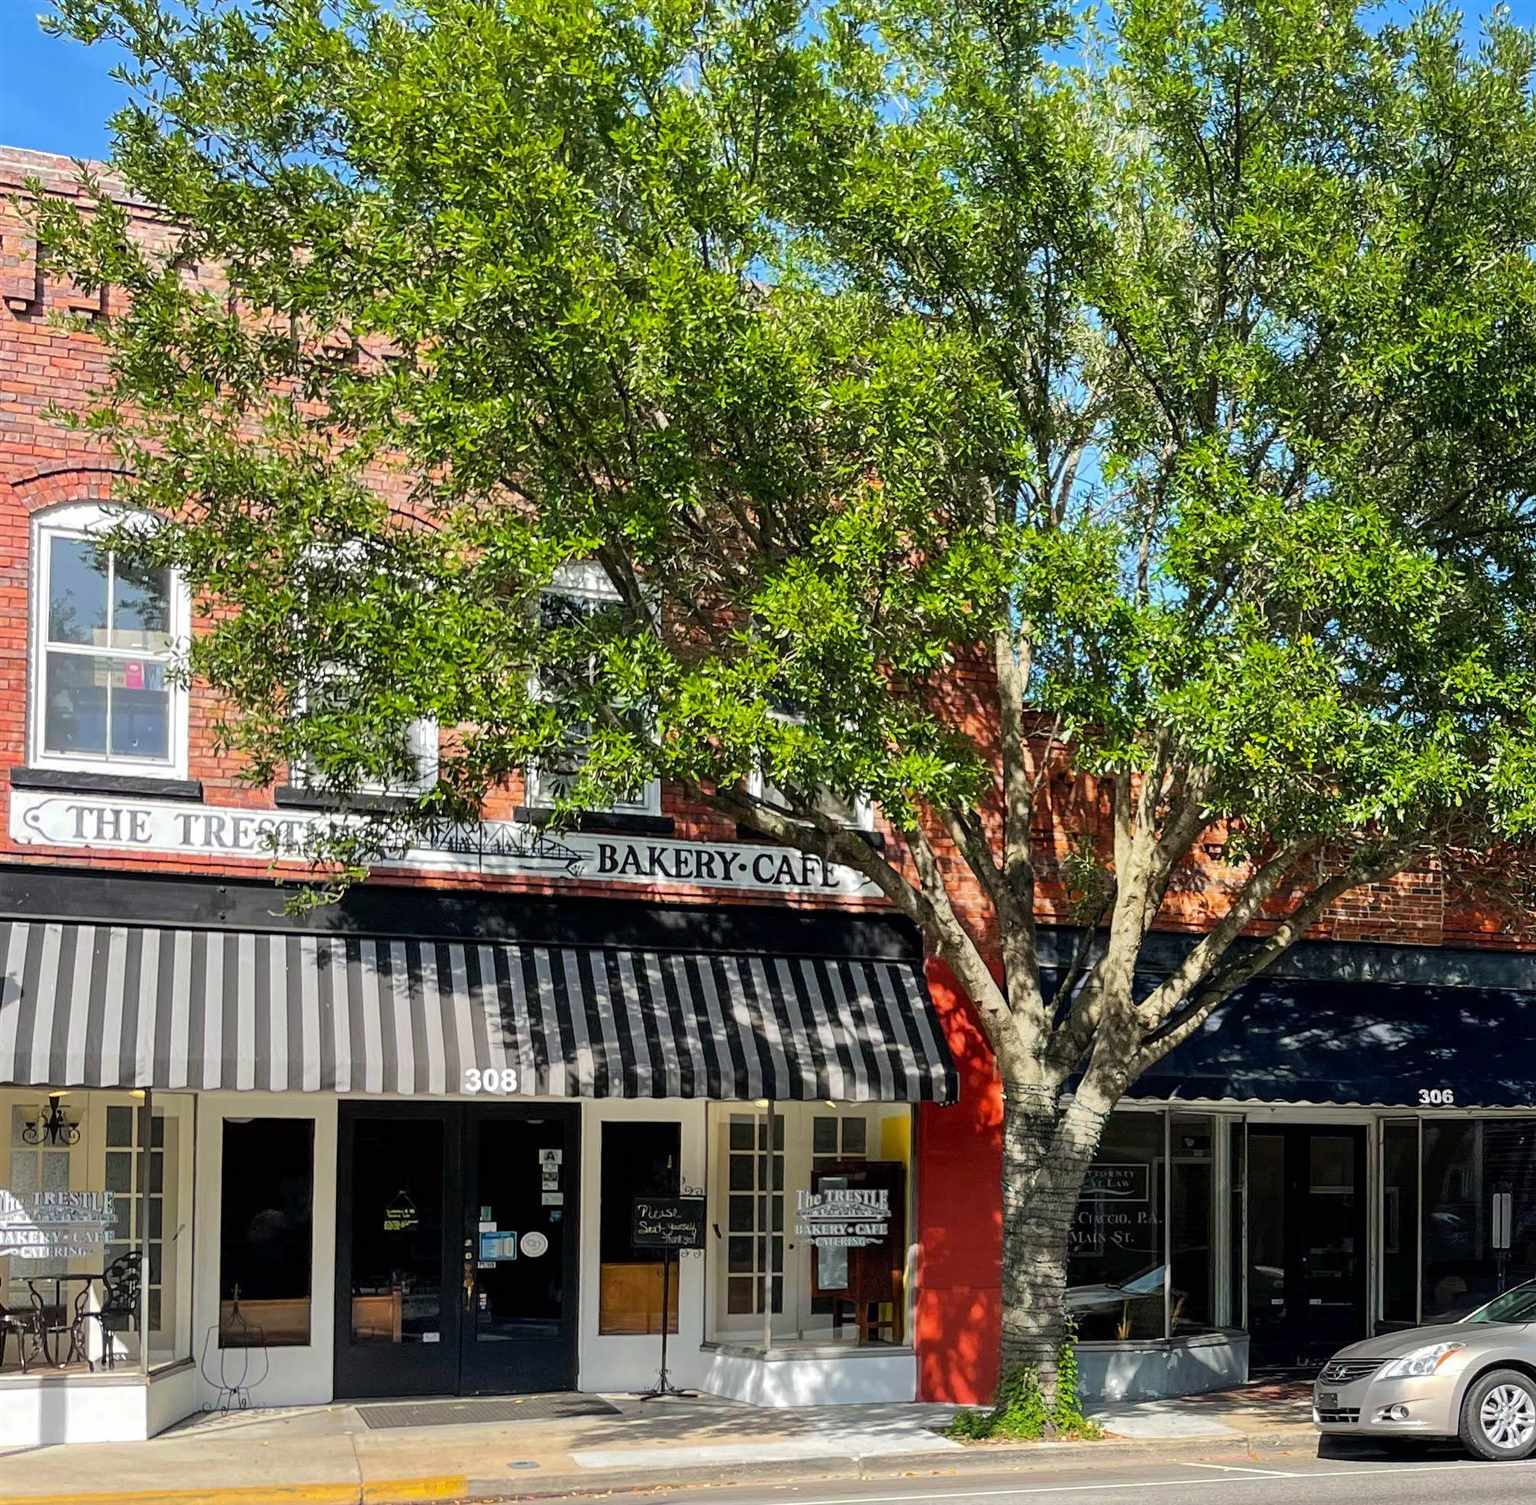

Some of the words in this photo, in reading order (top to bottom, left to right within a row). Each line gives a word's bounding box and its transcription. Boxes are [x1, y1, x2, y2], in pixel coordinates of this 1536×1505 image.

[66, 805, 153, 843] THE
[598, 843, 740, 881] BAKERY
[464, 1068, 518, 1092] 308
[1418, 1088, 1455, 1104] 306
[33, 1191, 114, 1216] TRESTLE
[796, 1190, 822, 1210] The
[824, 1189, 889, 1210] TRESTLE
[795, 1223, 848, 1235] BAKERY
[855, 1223, 889, 1236] CAFE
[815, 1236, 866, 1247] CATERING
